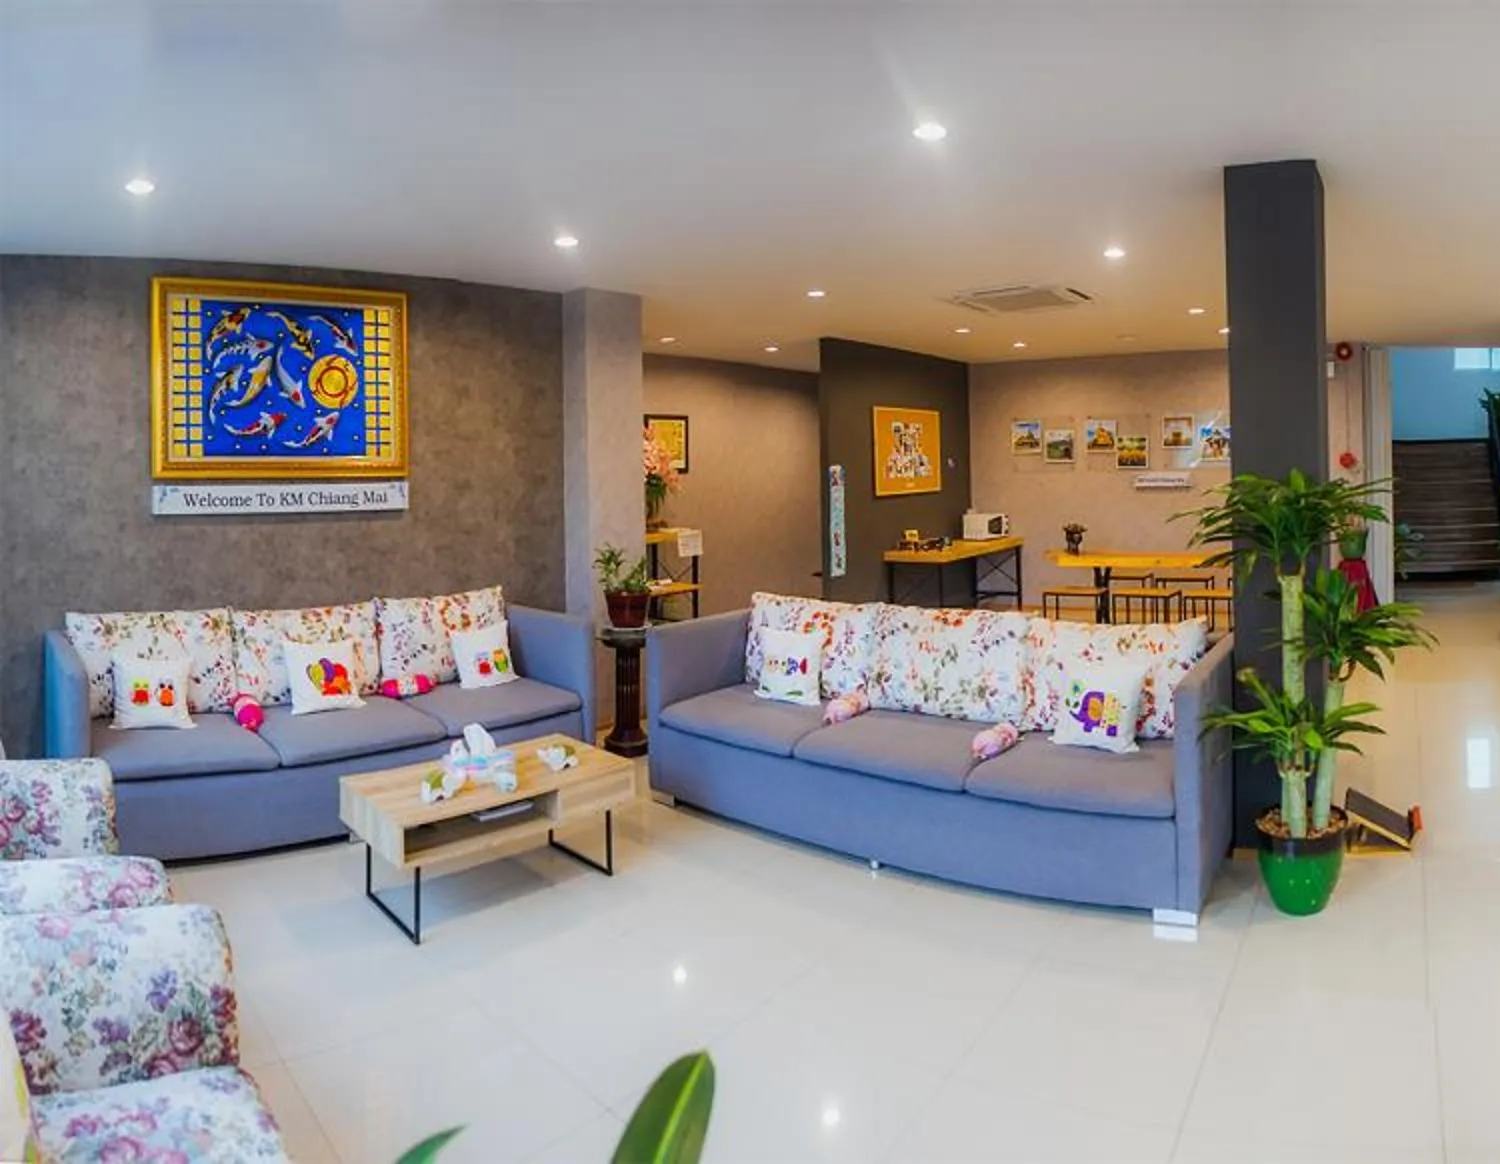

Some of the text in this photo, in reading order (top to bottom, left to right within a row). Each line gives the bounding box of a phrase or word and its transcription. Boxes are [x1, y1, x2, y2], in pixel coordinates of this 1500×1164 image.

[183, 490, 388, 508] Welcome To KM Chiang Mai
